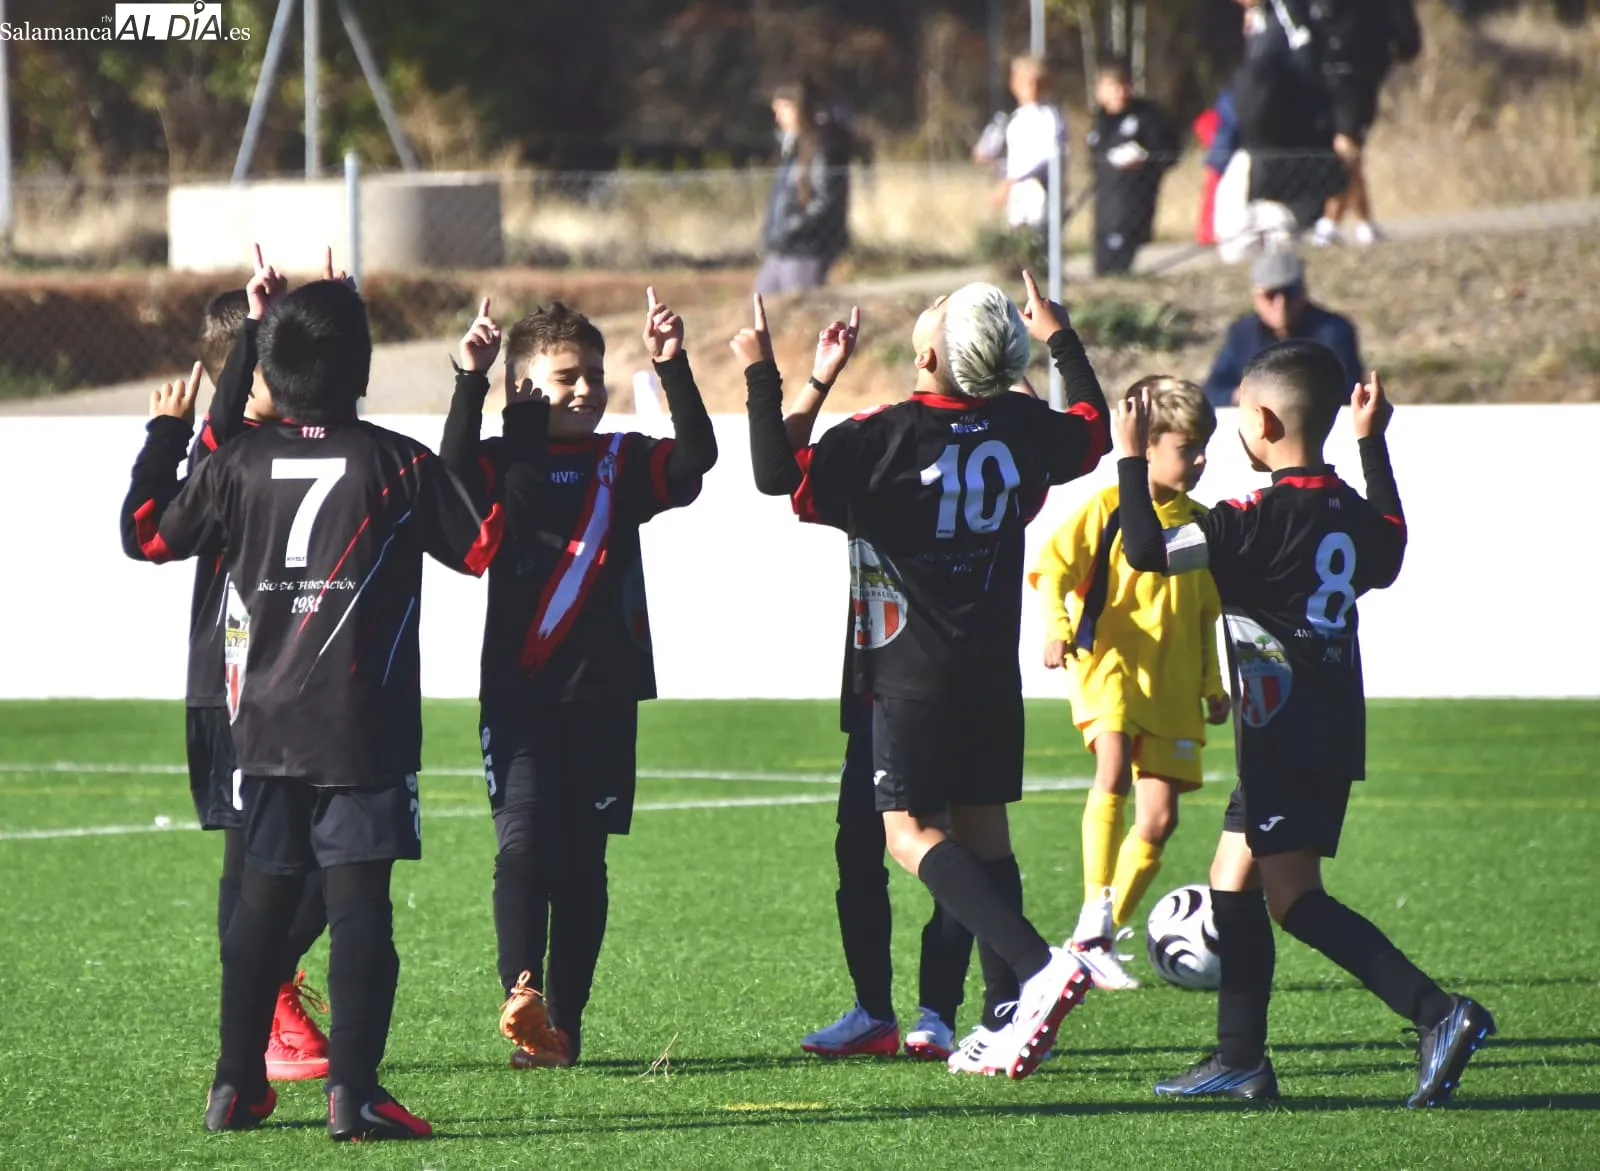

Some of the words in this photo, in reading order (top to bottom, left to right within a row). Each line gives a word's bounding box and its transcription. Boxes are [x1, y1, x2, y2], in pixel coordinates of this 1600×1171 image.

[271, 458, 346, 568] 7
[920, 440, 1021, 539] 10
[1306, 532, 1357, 636] 8
